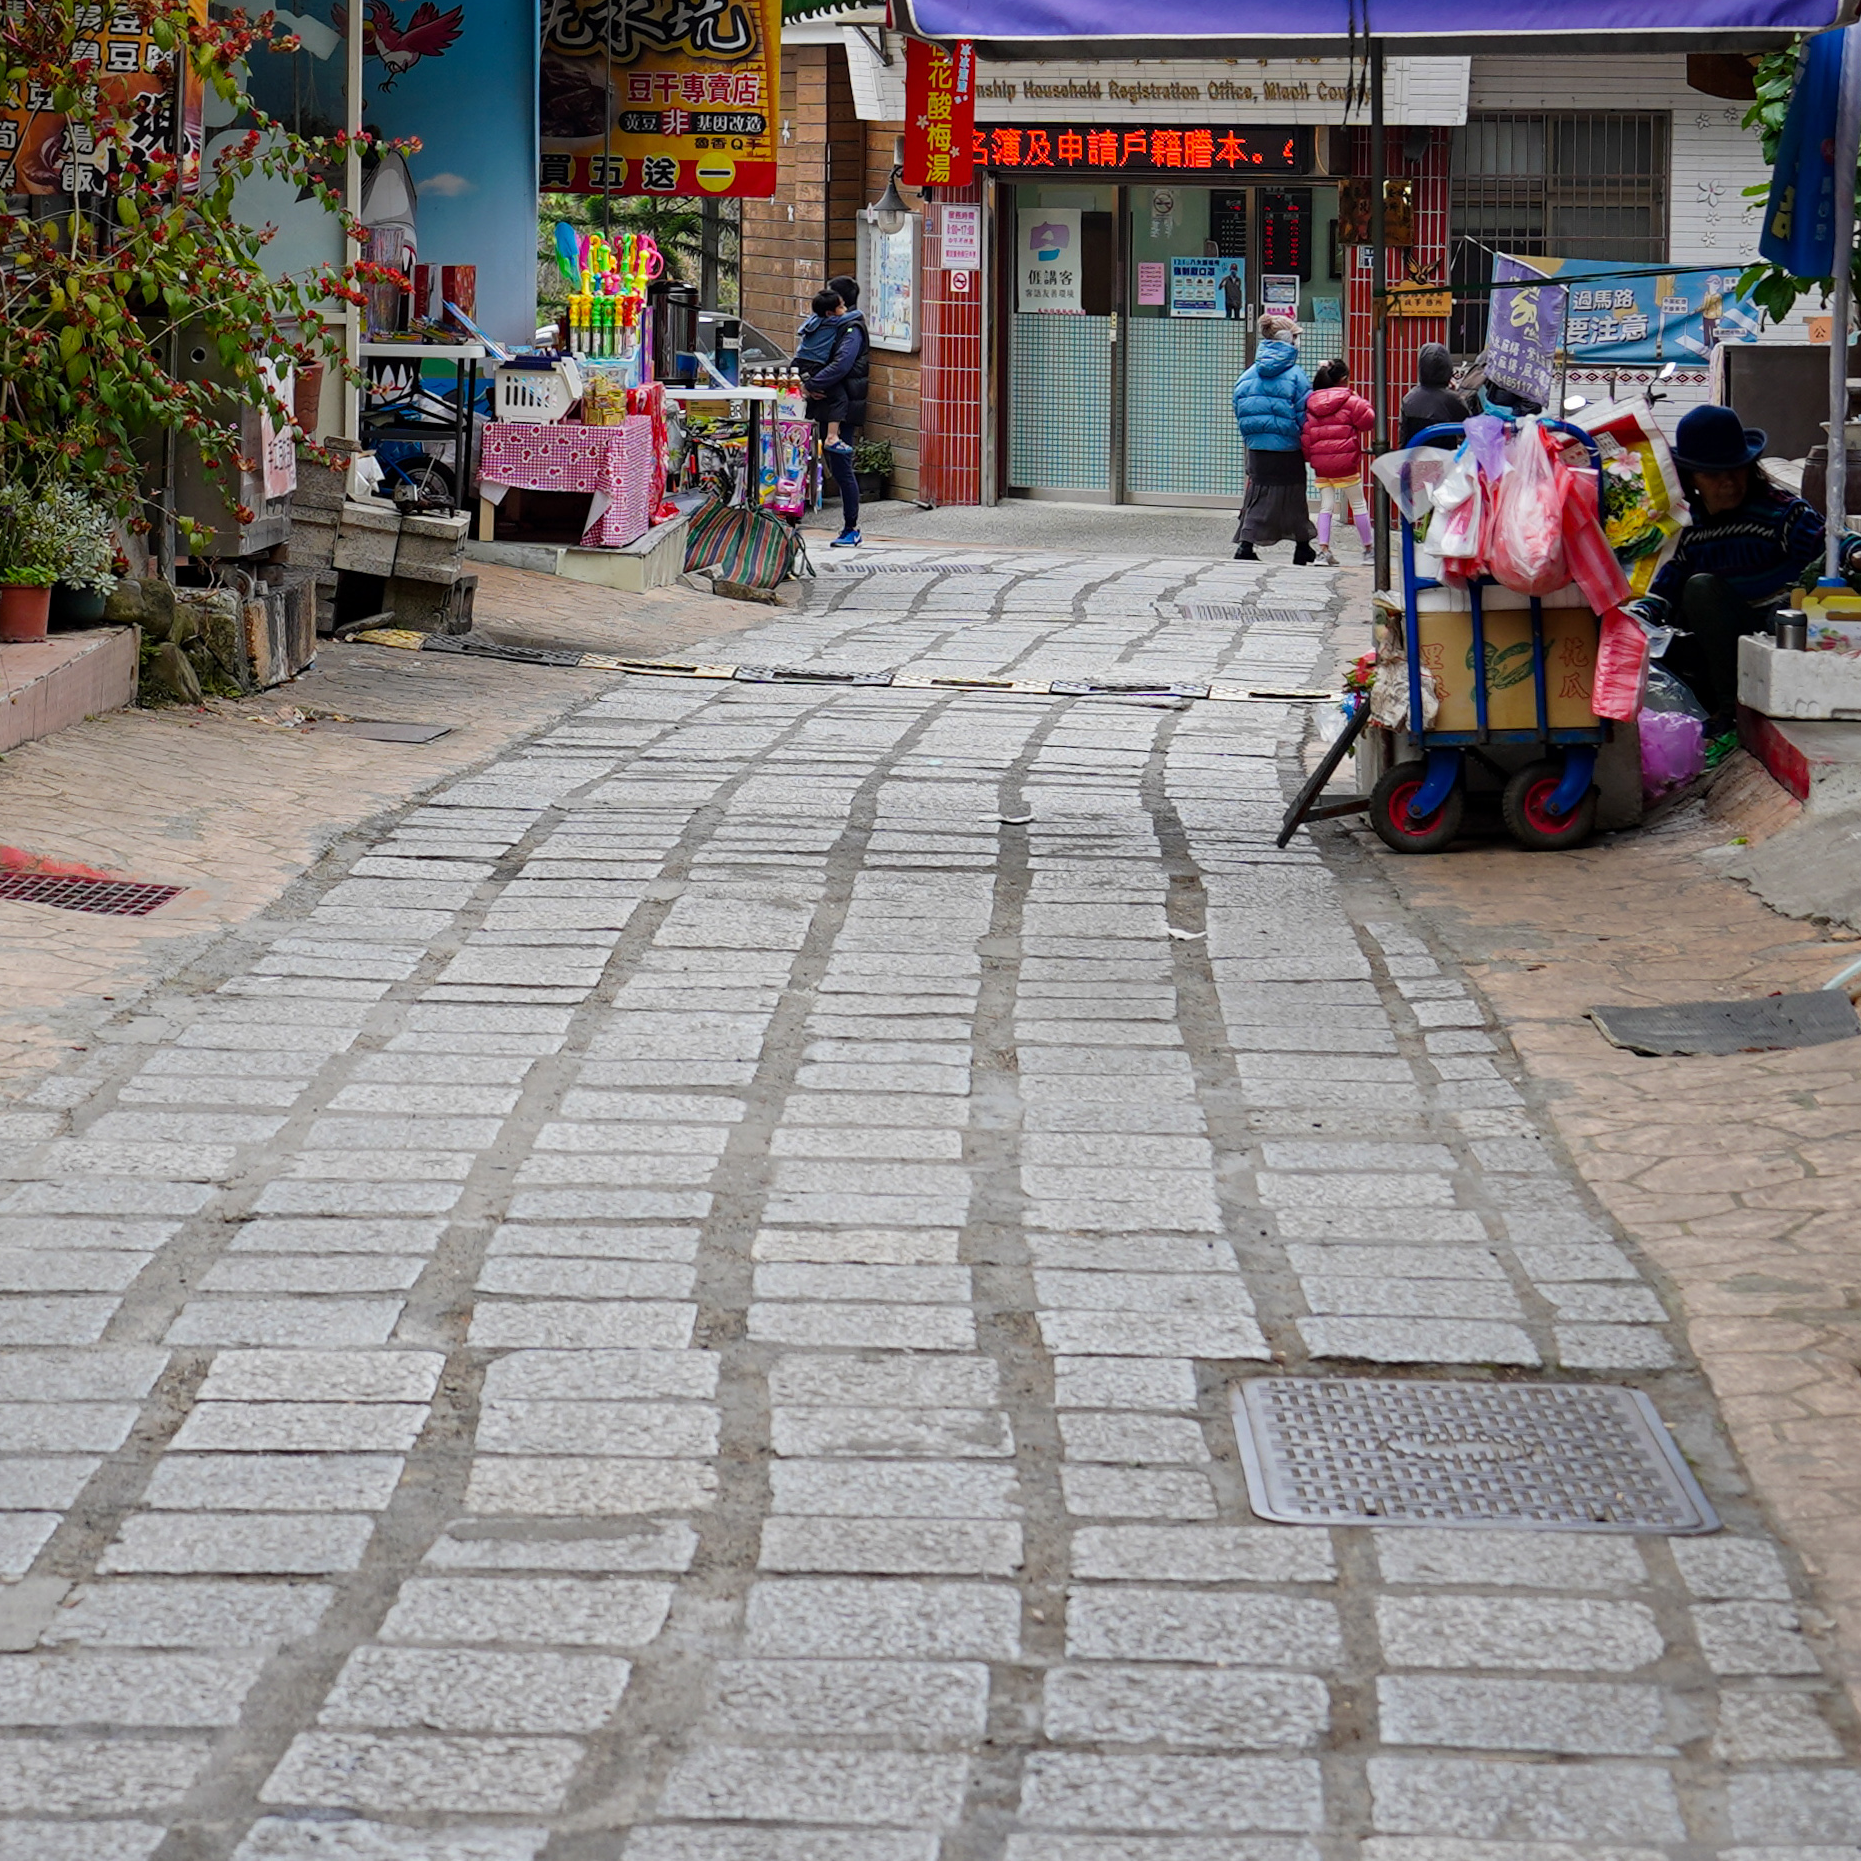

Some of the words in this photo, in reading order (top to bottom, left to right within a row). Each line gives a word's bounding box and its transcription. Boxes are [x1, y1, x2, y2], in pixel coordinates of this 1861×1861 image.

[627, 72, 760, 106] 豆干專賣店
[1022, 78, 1102, 100] Household
[1107, 79, 1201, 105] Registration
[1262, 80, 1310, 102] Miaoli
[661, 108, 691, 135] 非
[696, 114, 763, 133] 基因改造
[1572, 289, 1635, 312] 過馬路
[1561, 313, 1649, 345] 要注意
